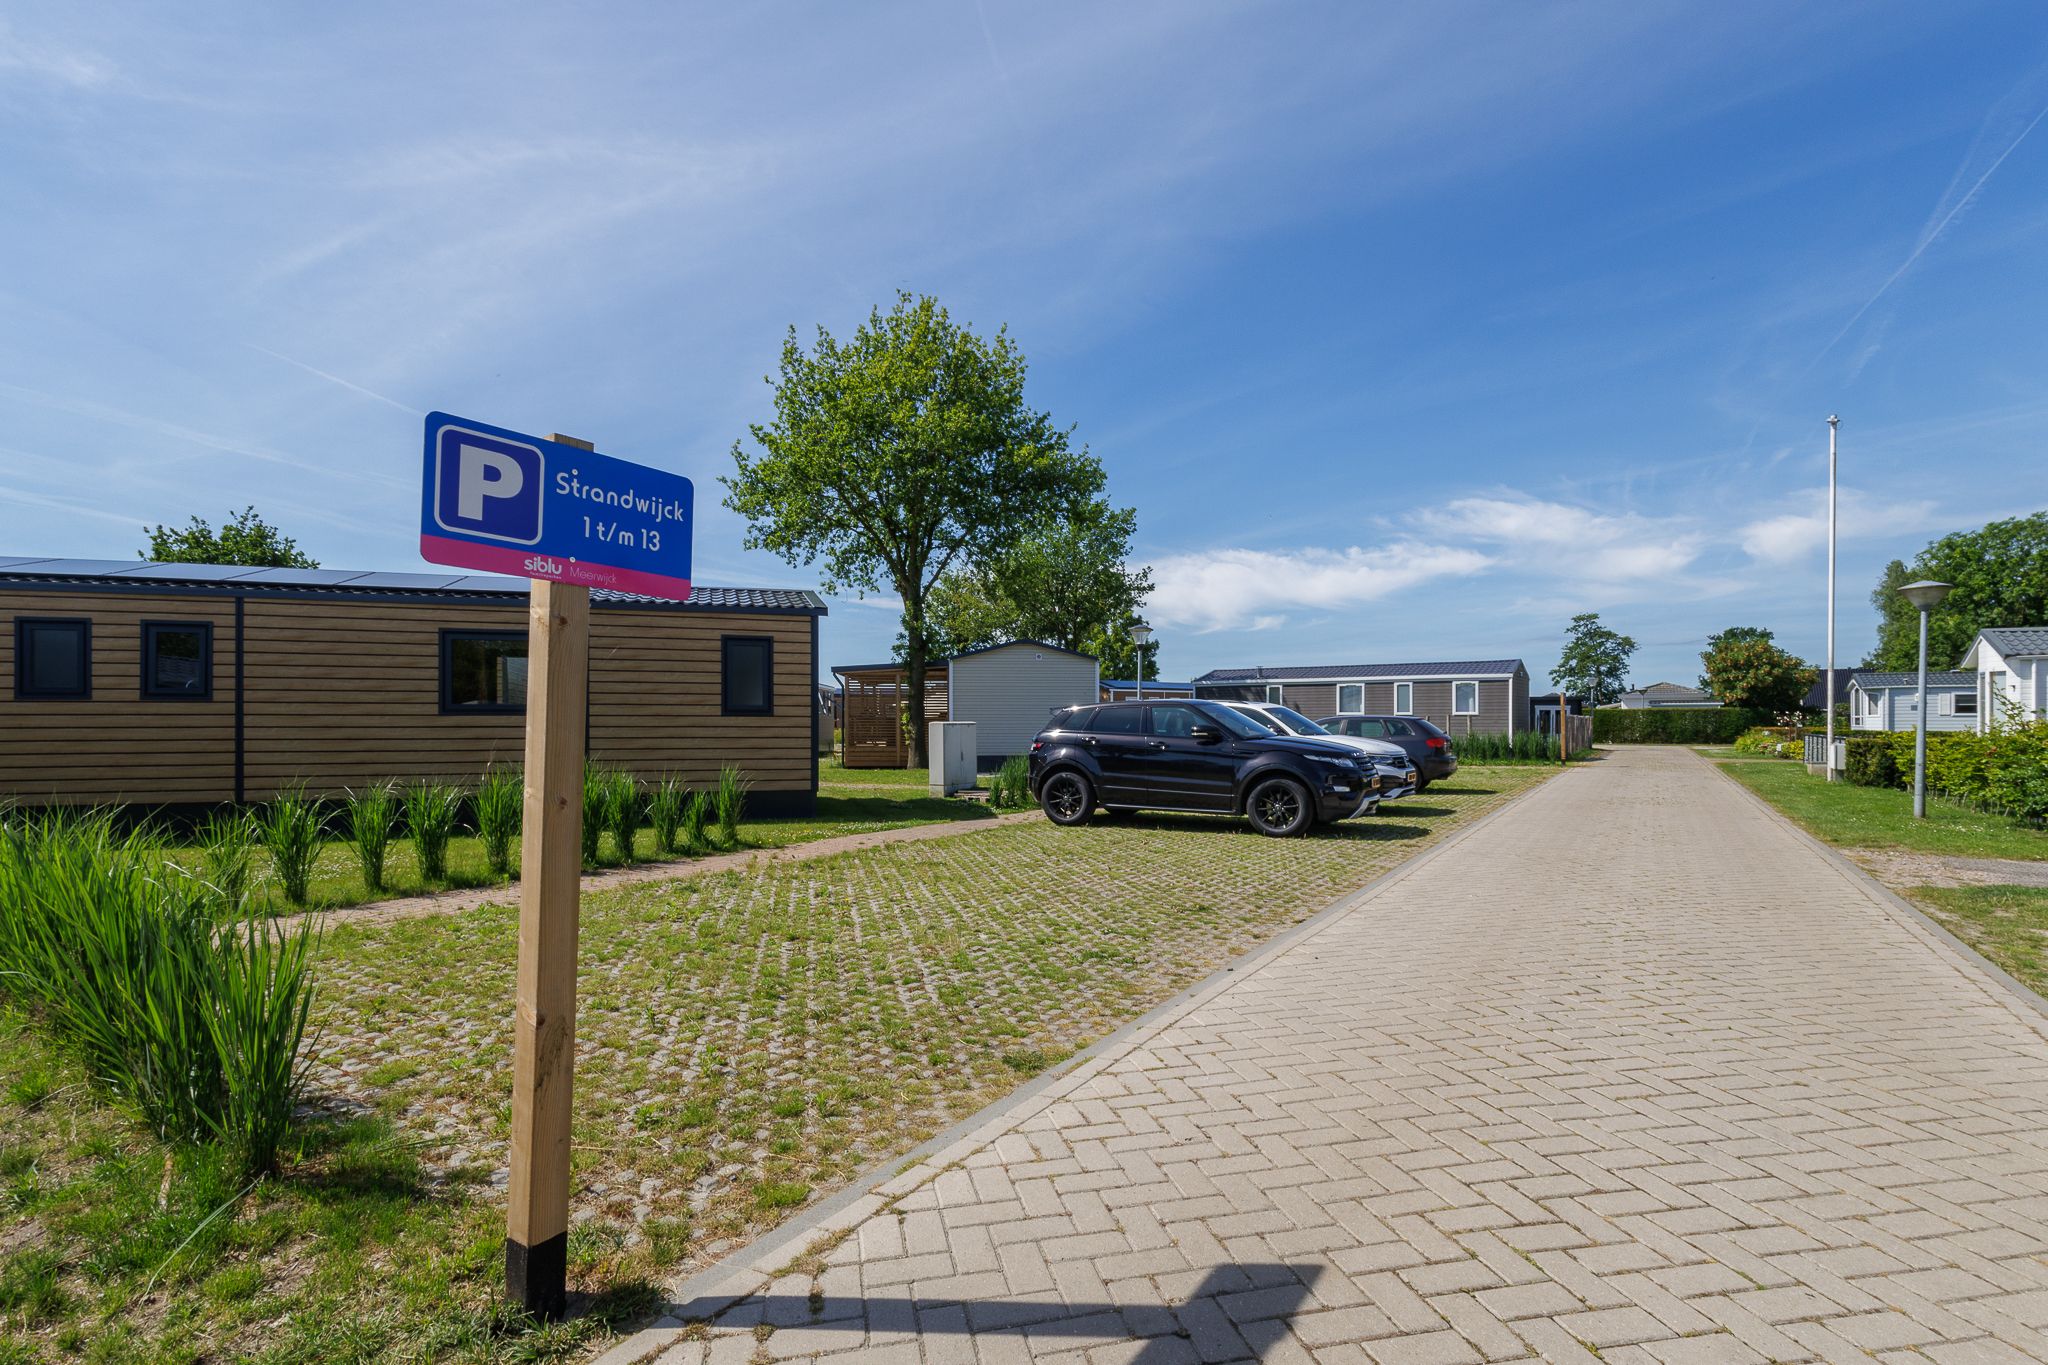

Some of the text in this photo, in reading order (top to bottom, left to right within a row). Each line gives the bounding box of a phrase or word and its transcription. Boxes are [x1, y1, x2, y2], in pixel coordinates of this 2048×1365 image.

[457, 443, 524, 521] P
[556, 472, 684, 522] Strandwijck
[583, 516, 661, 552] 1 t/m 13
[523, 556, 563, 574] siblu
[569, 566, 617, 585] Meerwijck
